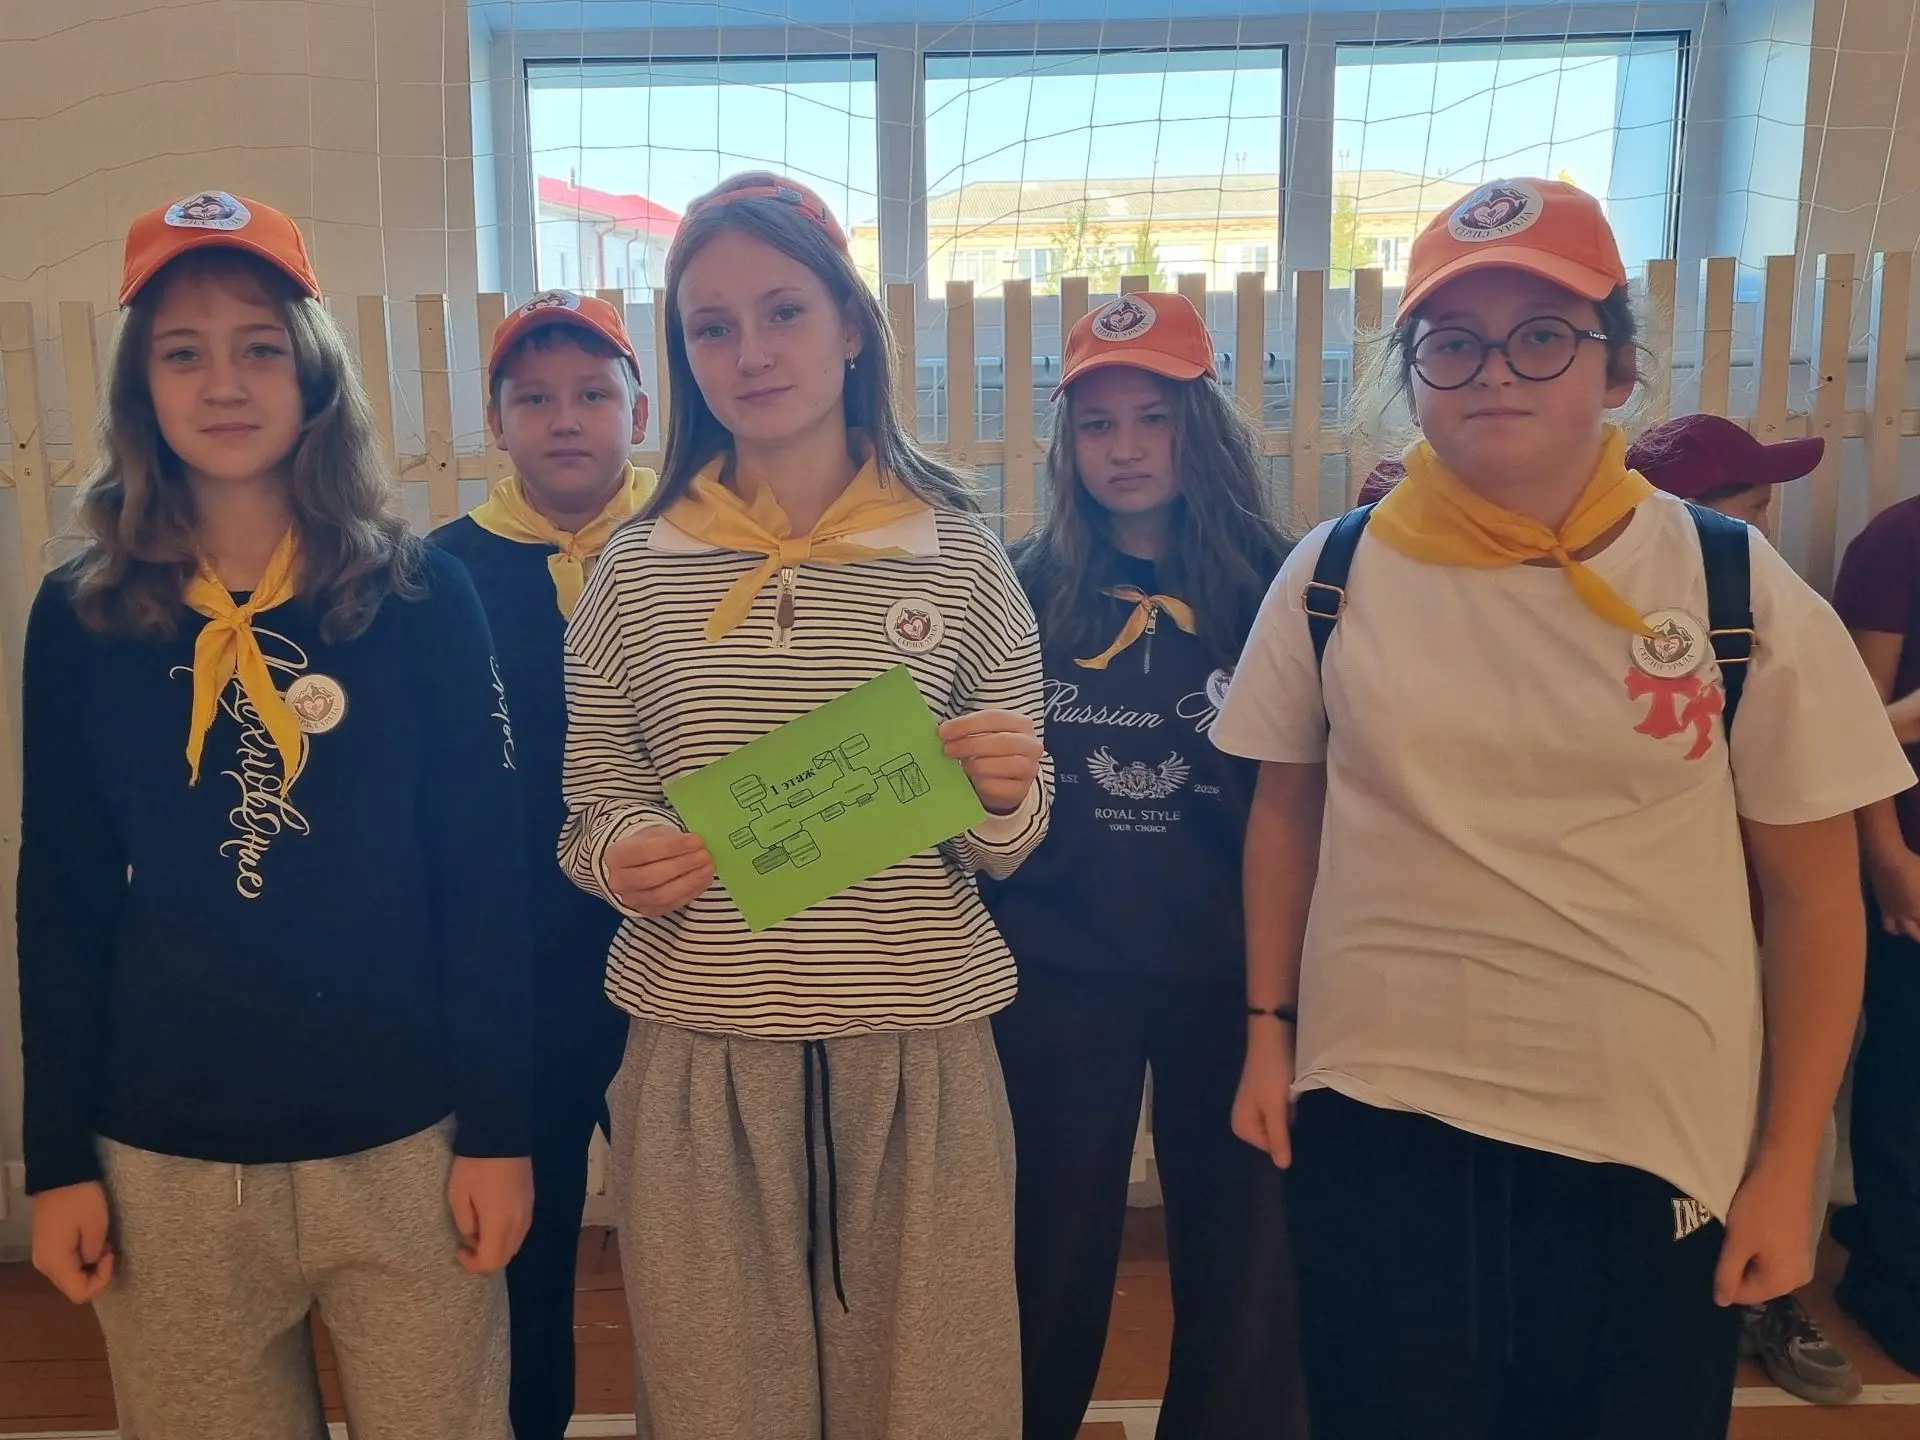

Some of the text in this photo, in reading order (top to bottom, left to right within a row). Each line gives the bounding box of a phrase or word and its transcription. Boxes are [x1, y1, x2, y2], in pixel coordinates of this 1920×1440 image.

[1496, 211, 1534, 234] УРАЛА
[1043, 679, 1165, 728] Russian
[769, 784, 779, 796] 1
[781, 767, 817, 789] этаж
[1094, 808, 1181, 821] ROYAL STYLE
[1109, 823, 1167, 833] YOUR CHOICE
